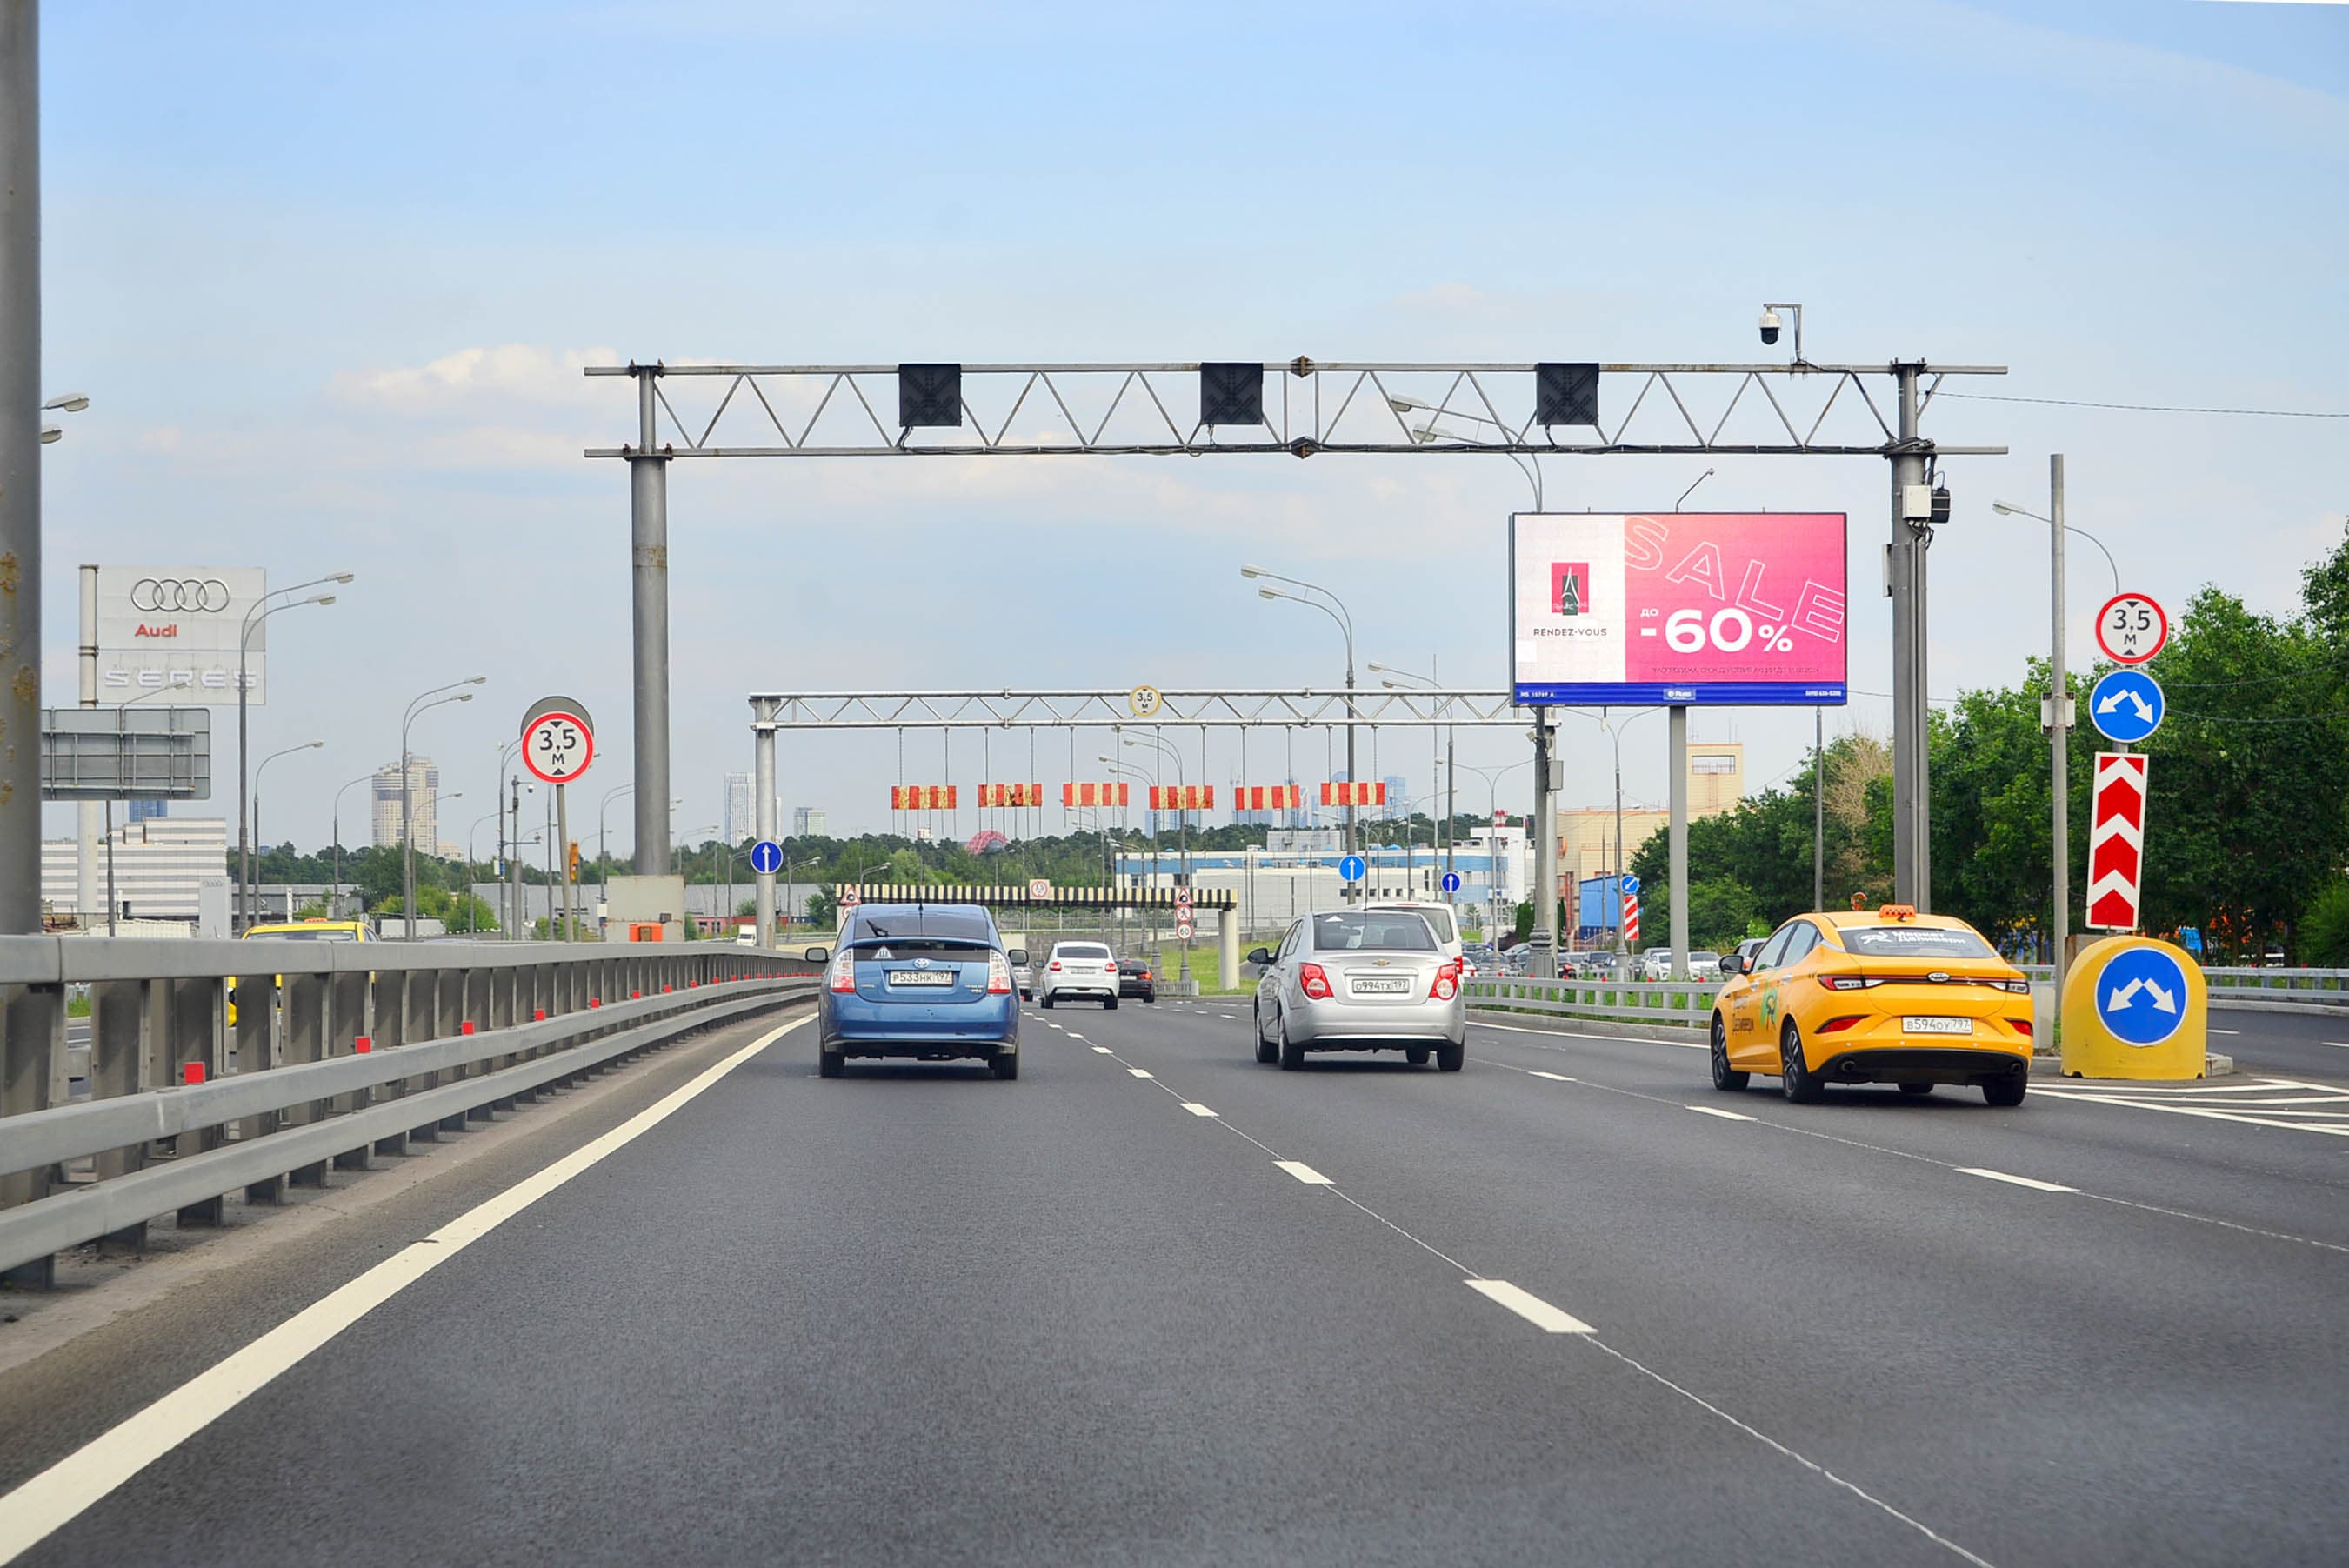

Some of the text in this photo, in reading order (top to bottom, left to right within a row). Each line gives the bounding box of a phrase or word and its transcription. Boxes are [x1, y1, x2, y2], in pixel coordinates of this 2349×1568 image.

[1625, 515, 1845, 643] SALE
[135, 624, 178, 637] Audi
[2112, 609, 2151, 633] 3,5
[104, 669, 257, 688] SERES
[1137, 692, 1153, 703] 3,5
[539, 729, 576, 752] 3,5
[1179, 927, 1190, 936] 60
